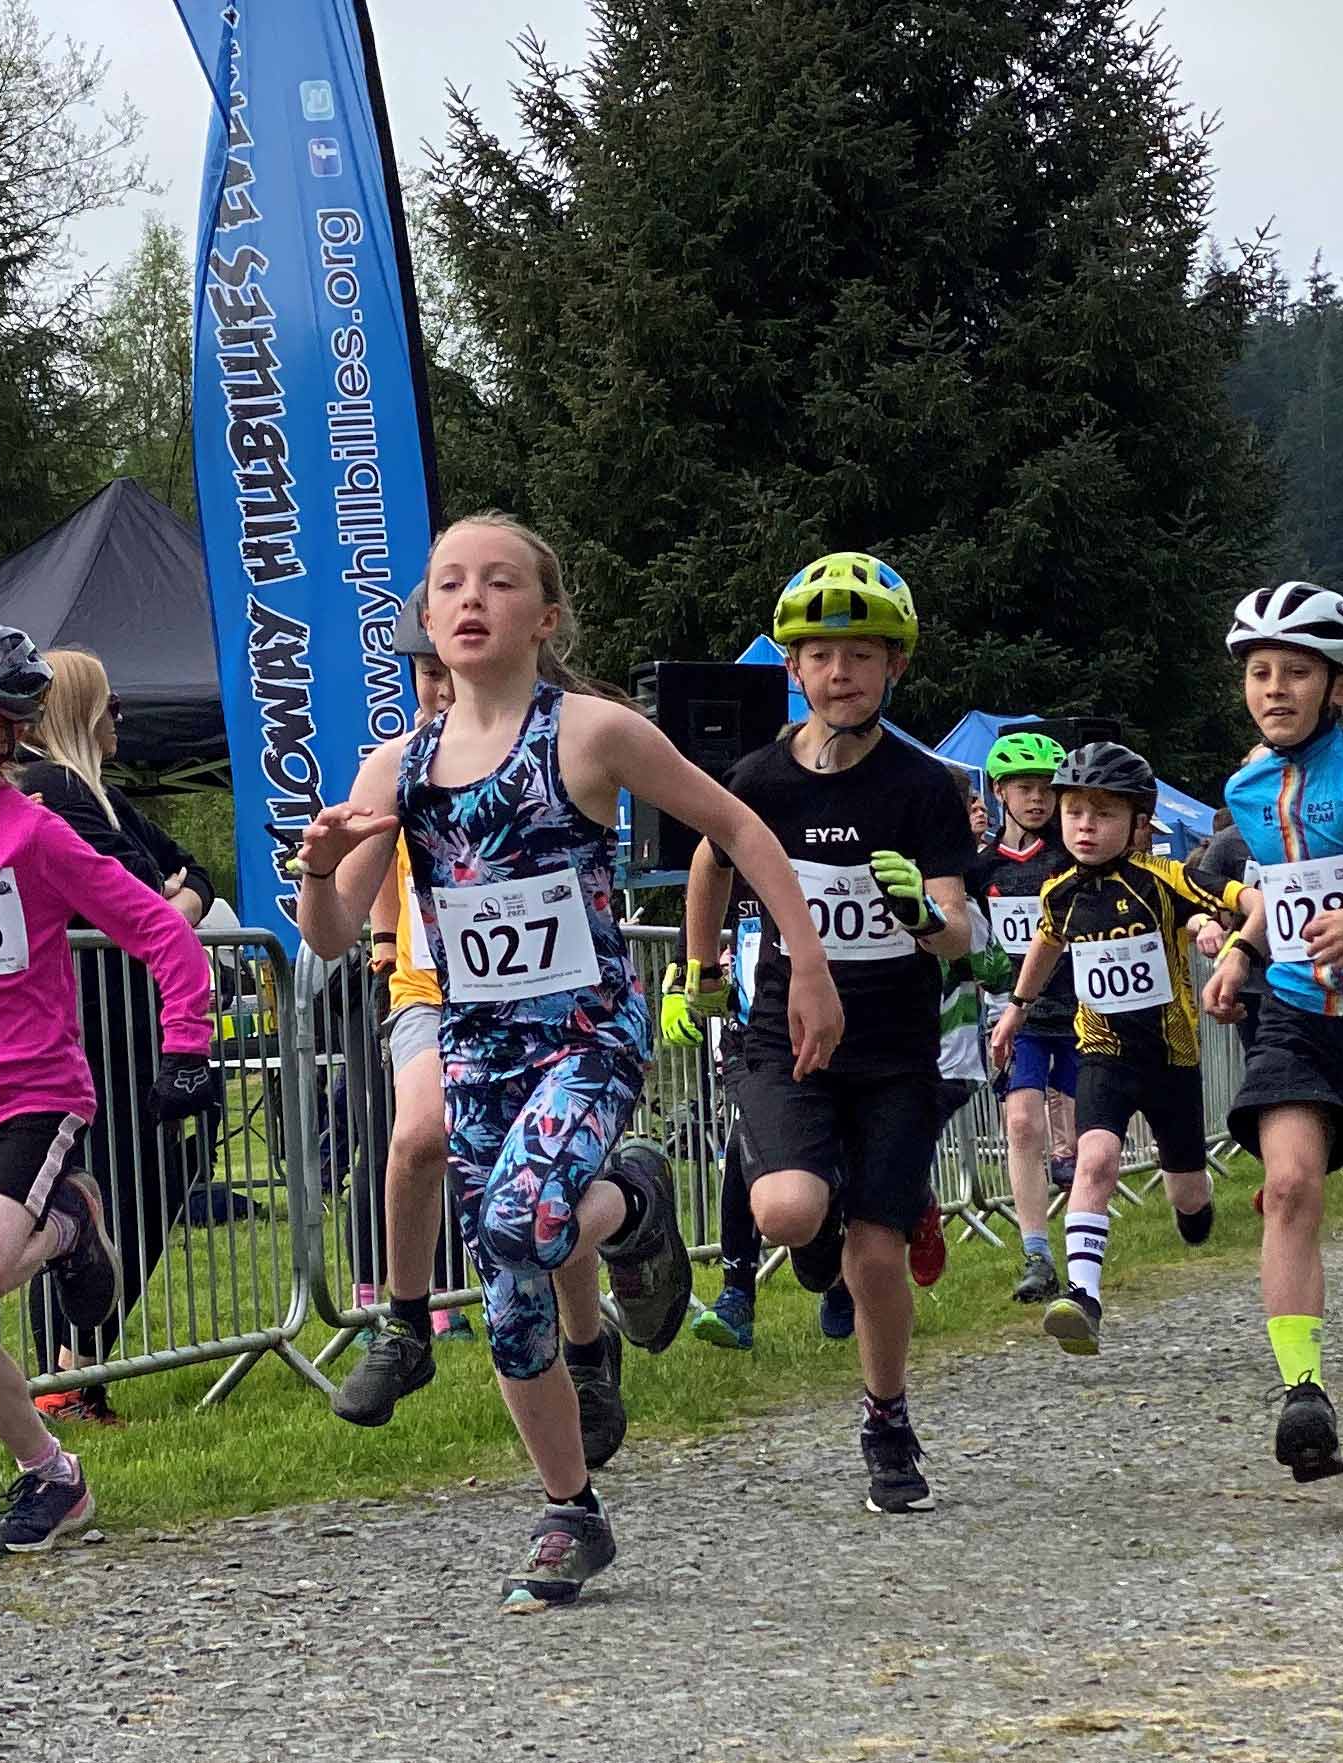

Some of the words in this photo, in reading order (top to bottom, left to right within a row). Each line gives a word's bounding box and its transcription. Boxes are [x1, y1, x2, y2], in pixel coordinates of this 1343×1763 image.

[206, 244, 307, 587] HILLBILLIES
[1307, 800, 1335, 812] RACE
[1308, 811, 1335, 825] TEAM
[805, 826, 860, 843] EYRA
[1003, 917, 1042, 942] 01
[460, 916, 560, 978] 027
[1088, 961, 1154, 999] 008
